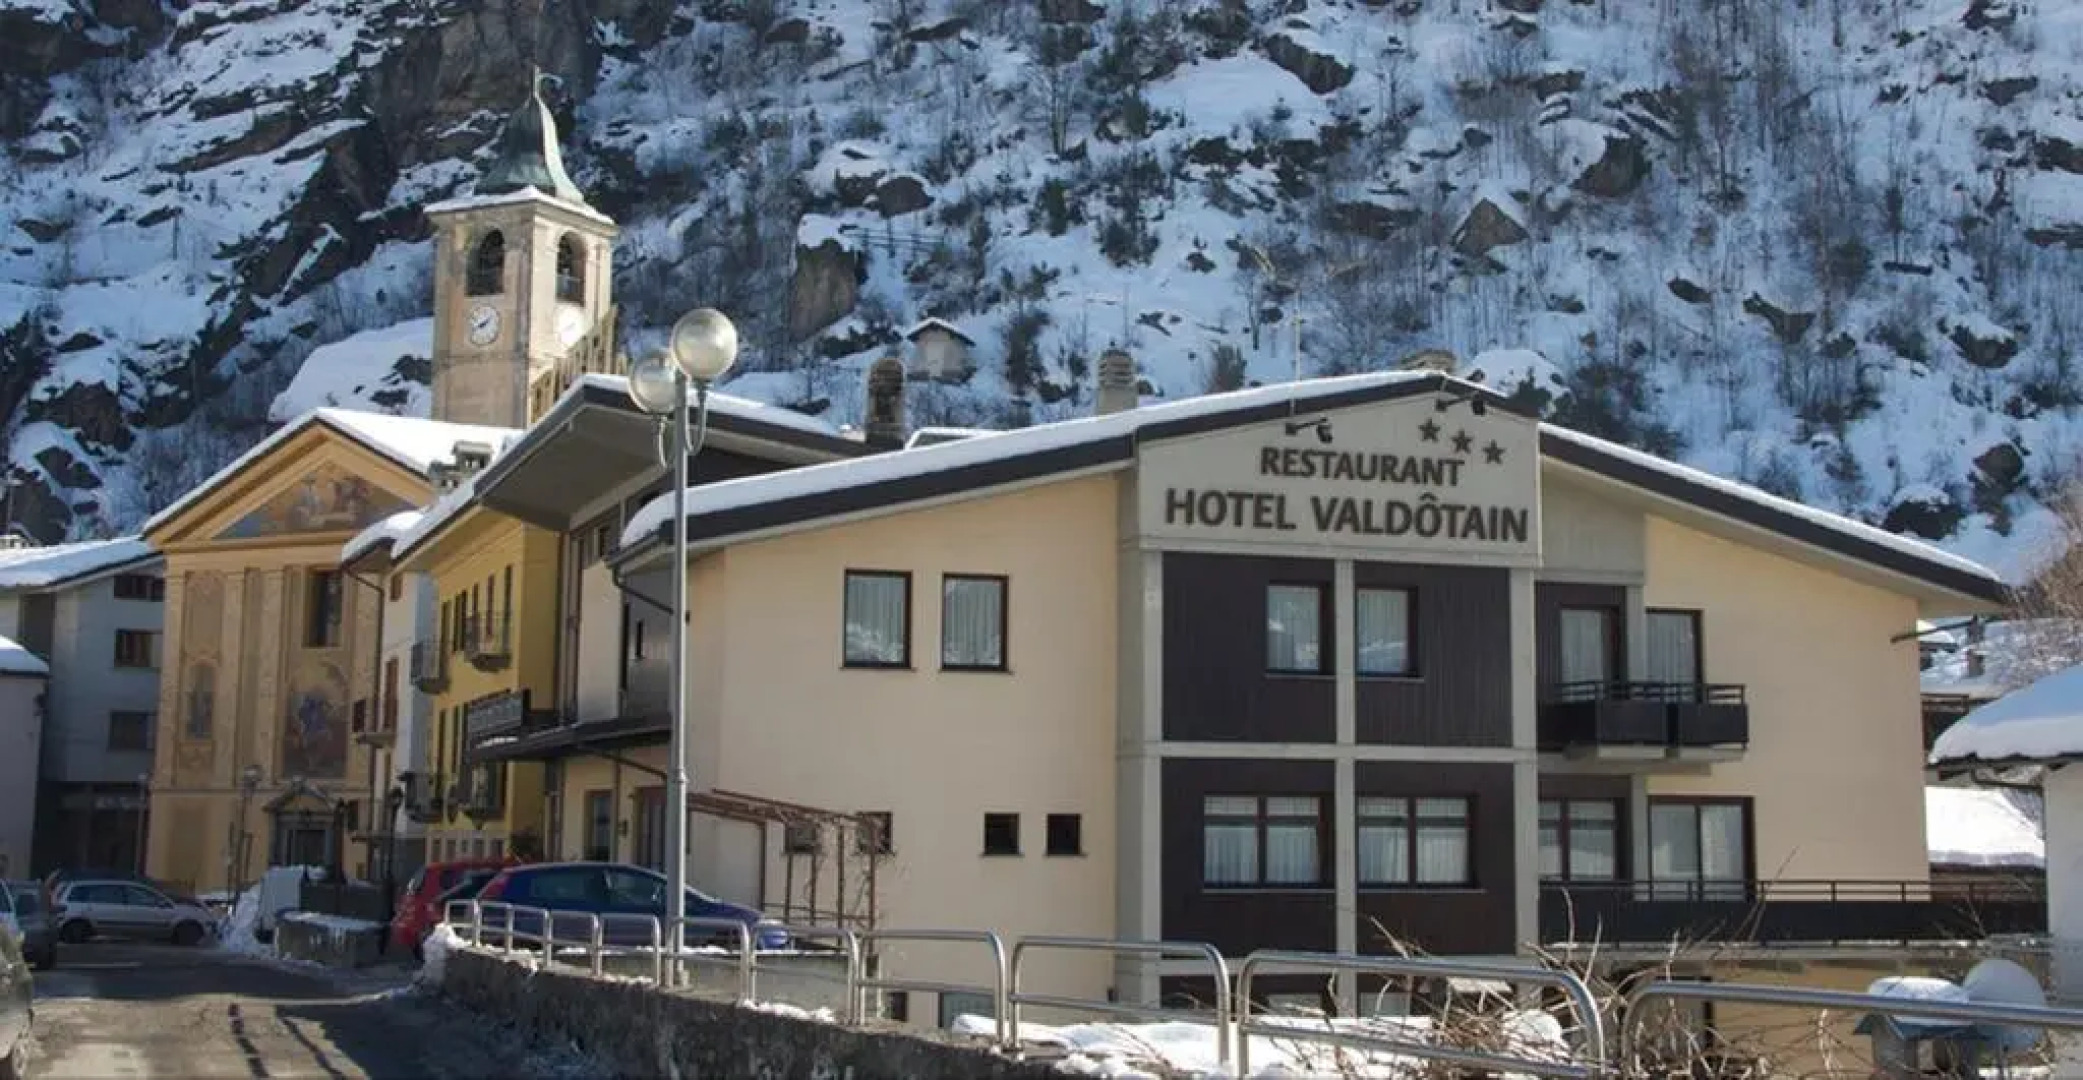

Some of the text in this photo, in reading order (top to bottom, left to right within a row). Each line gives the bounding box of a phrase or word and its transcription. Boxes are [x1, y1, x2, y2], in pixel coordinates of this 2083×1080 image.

[1260, 446, 1465, 487] RESTAURANT
[1165, 488, 1529, 543] HOTEL VALDÔTAIN
